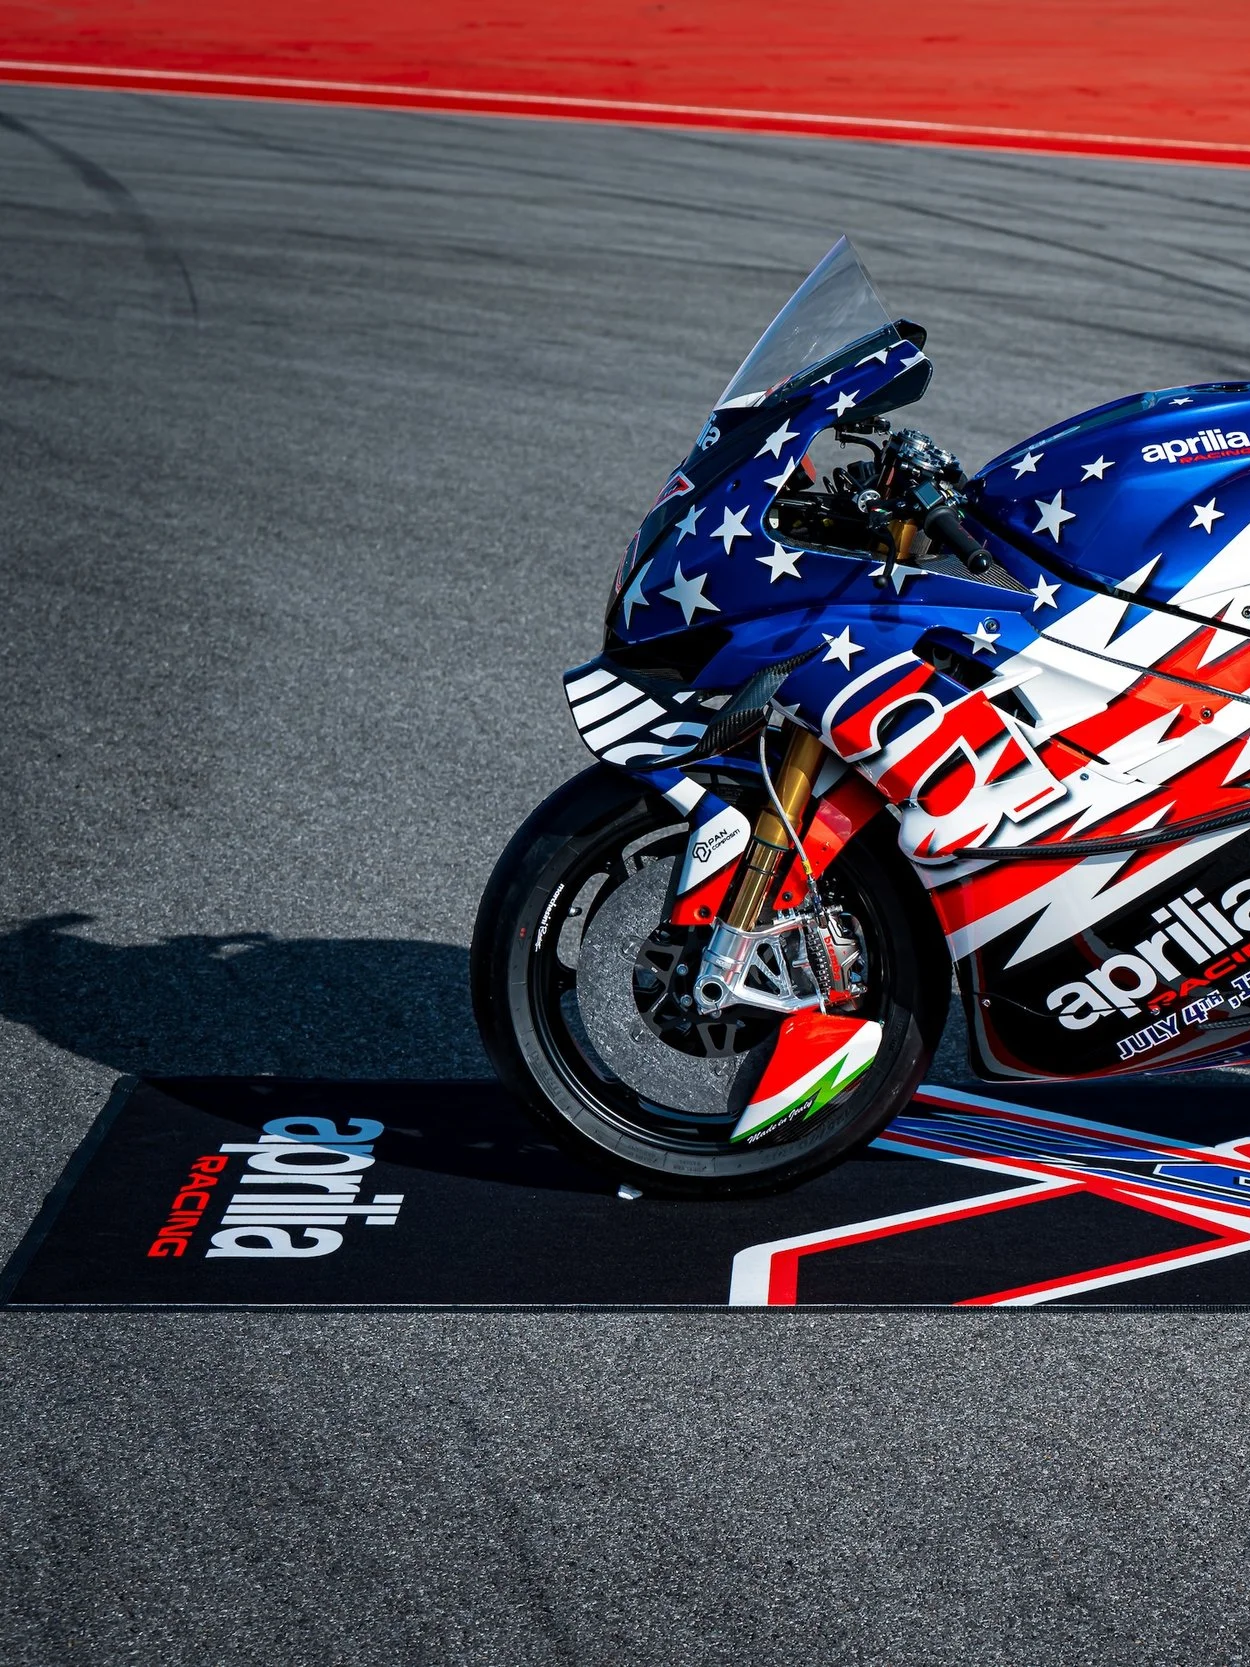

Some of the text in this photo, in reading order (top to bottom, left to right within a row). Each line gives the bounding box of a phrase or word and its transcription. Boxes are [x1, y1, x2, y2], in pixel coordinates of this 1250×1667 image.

[707, 828, 728, 846] PAN
[823, 934, 842, 982] brembo
[1116, 1013, 1180, 1061] JULY
[746, 1122, 778, 1145] Made
[788, 1099, 814, 1122] Italy
[147, 1154, 229, 1258] RACING
[205, 1115, 405, 1258] aprilia
